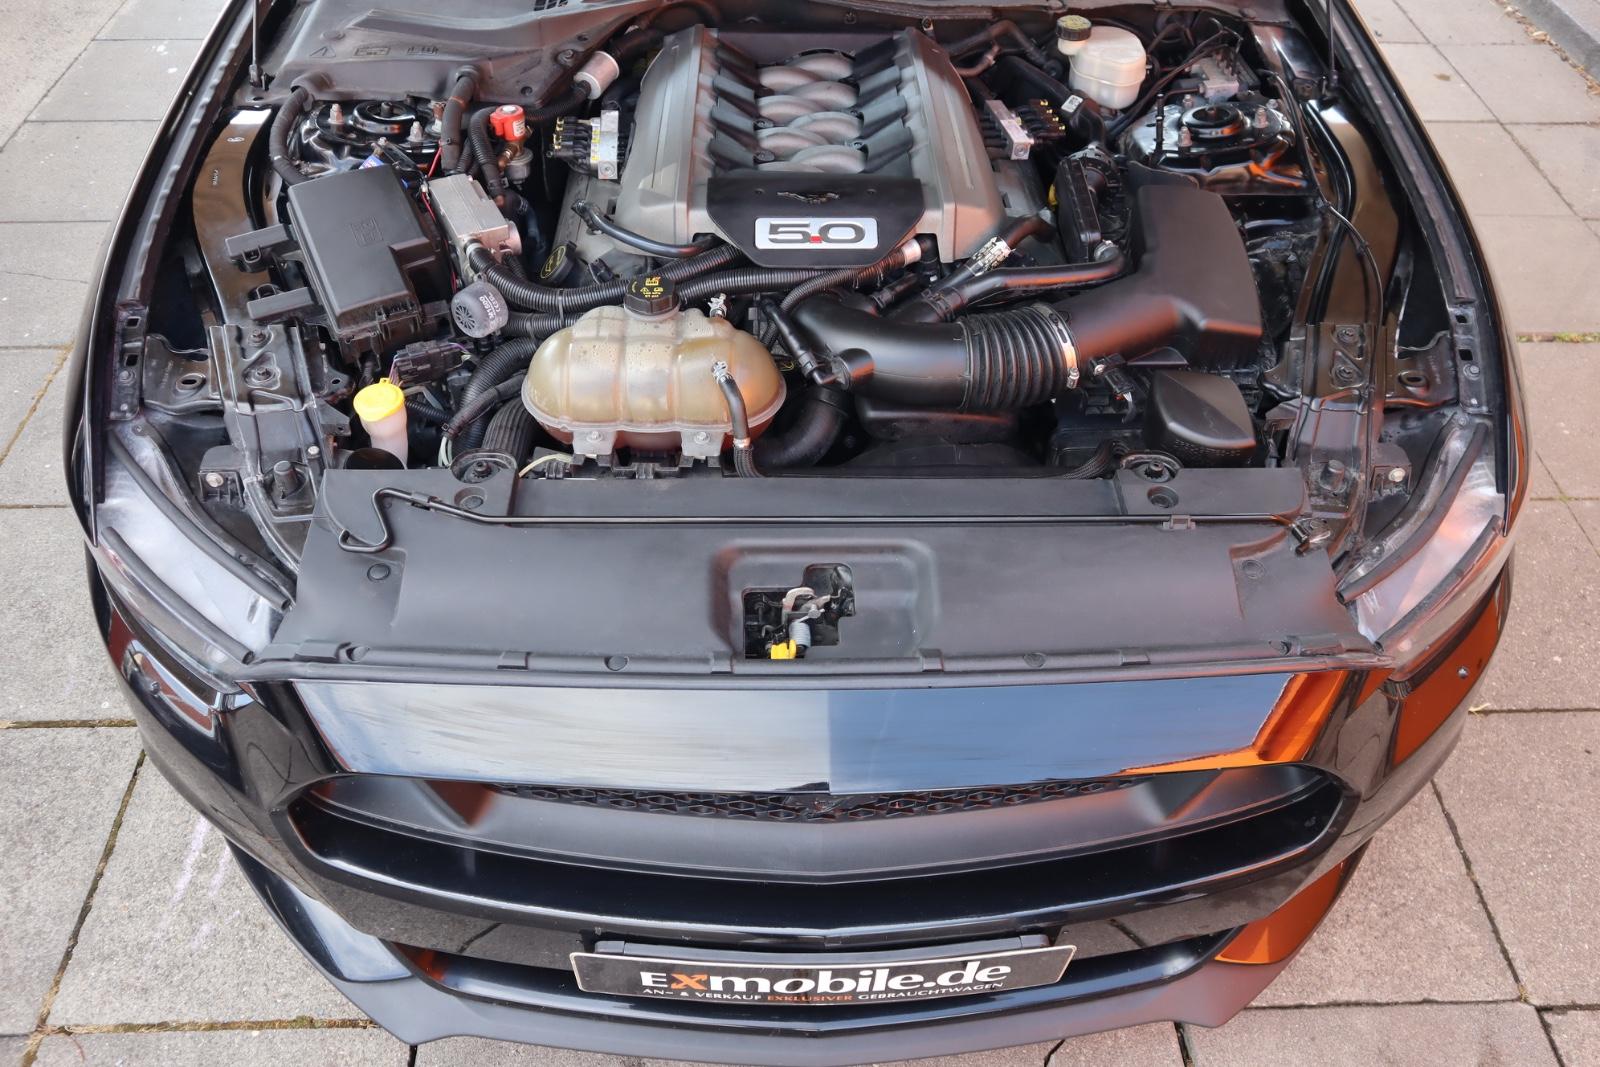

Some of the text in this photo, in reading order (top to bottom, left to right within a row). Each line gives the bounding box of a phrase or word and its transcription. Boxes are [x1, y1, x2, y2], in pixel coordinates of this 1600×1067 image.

[768, 222, 866, 244] 5.0
[640, 961, 1012, 993] Exmobile.de
[695, 992, 762, 1001] VERKAUF
[858, 982, 1004, 1000] GEBRAUCHTWAGEN
